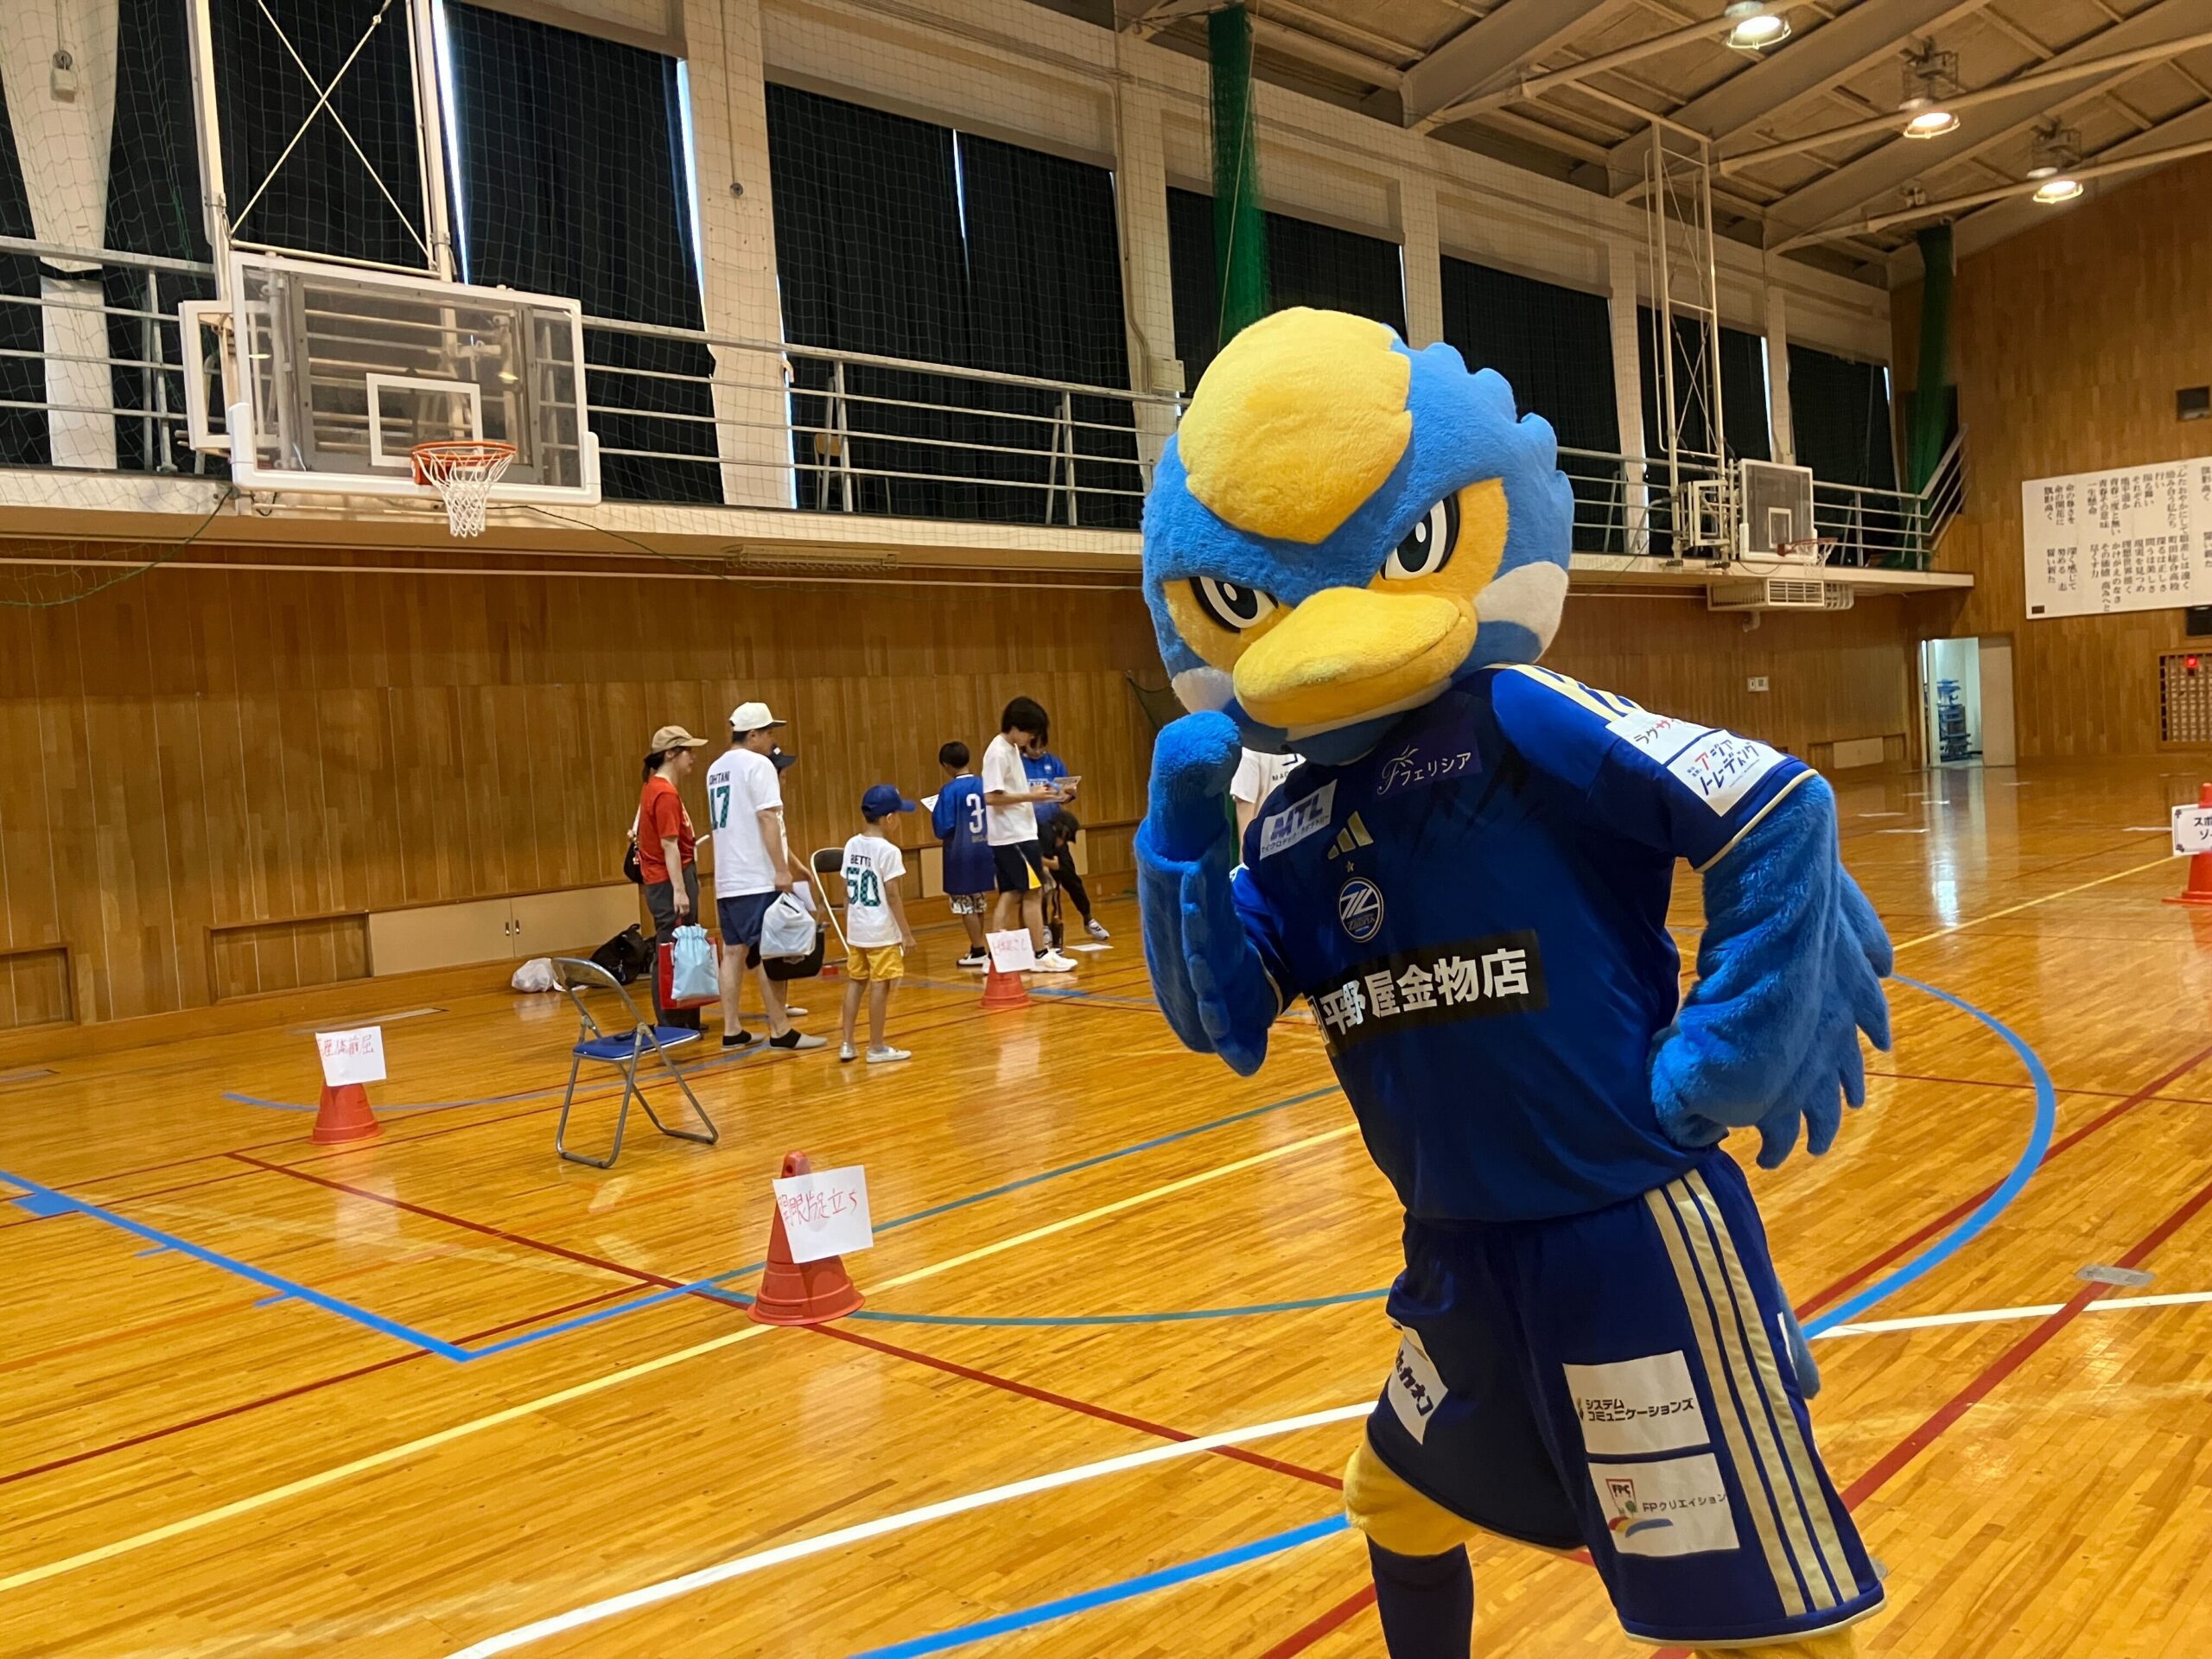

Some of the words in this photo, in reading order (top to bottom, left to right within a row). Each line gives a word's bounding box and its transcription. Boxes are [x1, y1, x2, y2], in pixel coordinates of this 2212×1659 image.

[1401, 752, 1471, 786] フェリシア
[1694, 739, 1732, 771] アジア
[1700, 741, 1759, 796] トレーディング
[710, 785, 731, 830] 17
[847, 867, 881, 907] 50
[1586, 1399, 1624, 1410] システム
[1587, 1398, 1694, 1422] コミュニケーションズ
